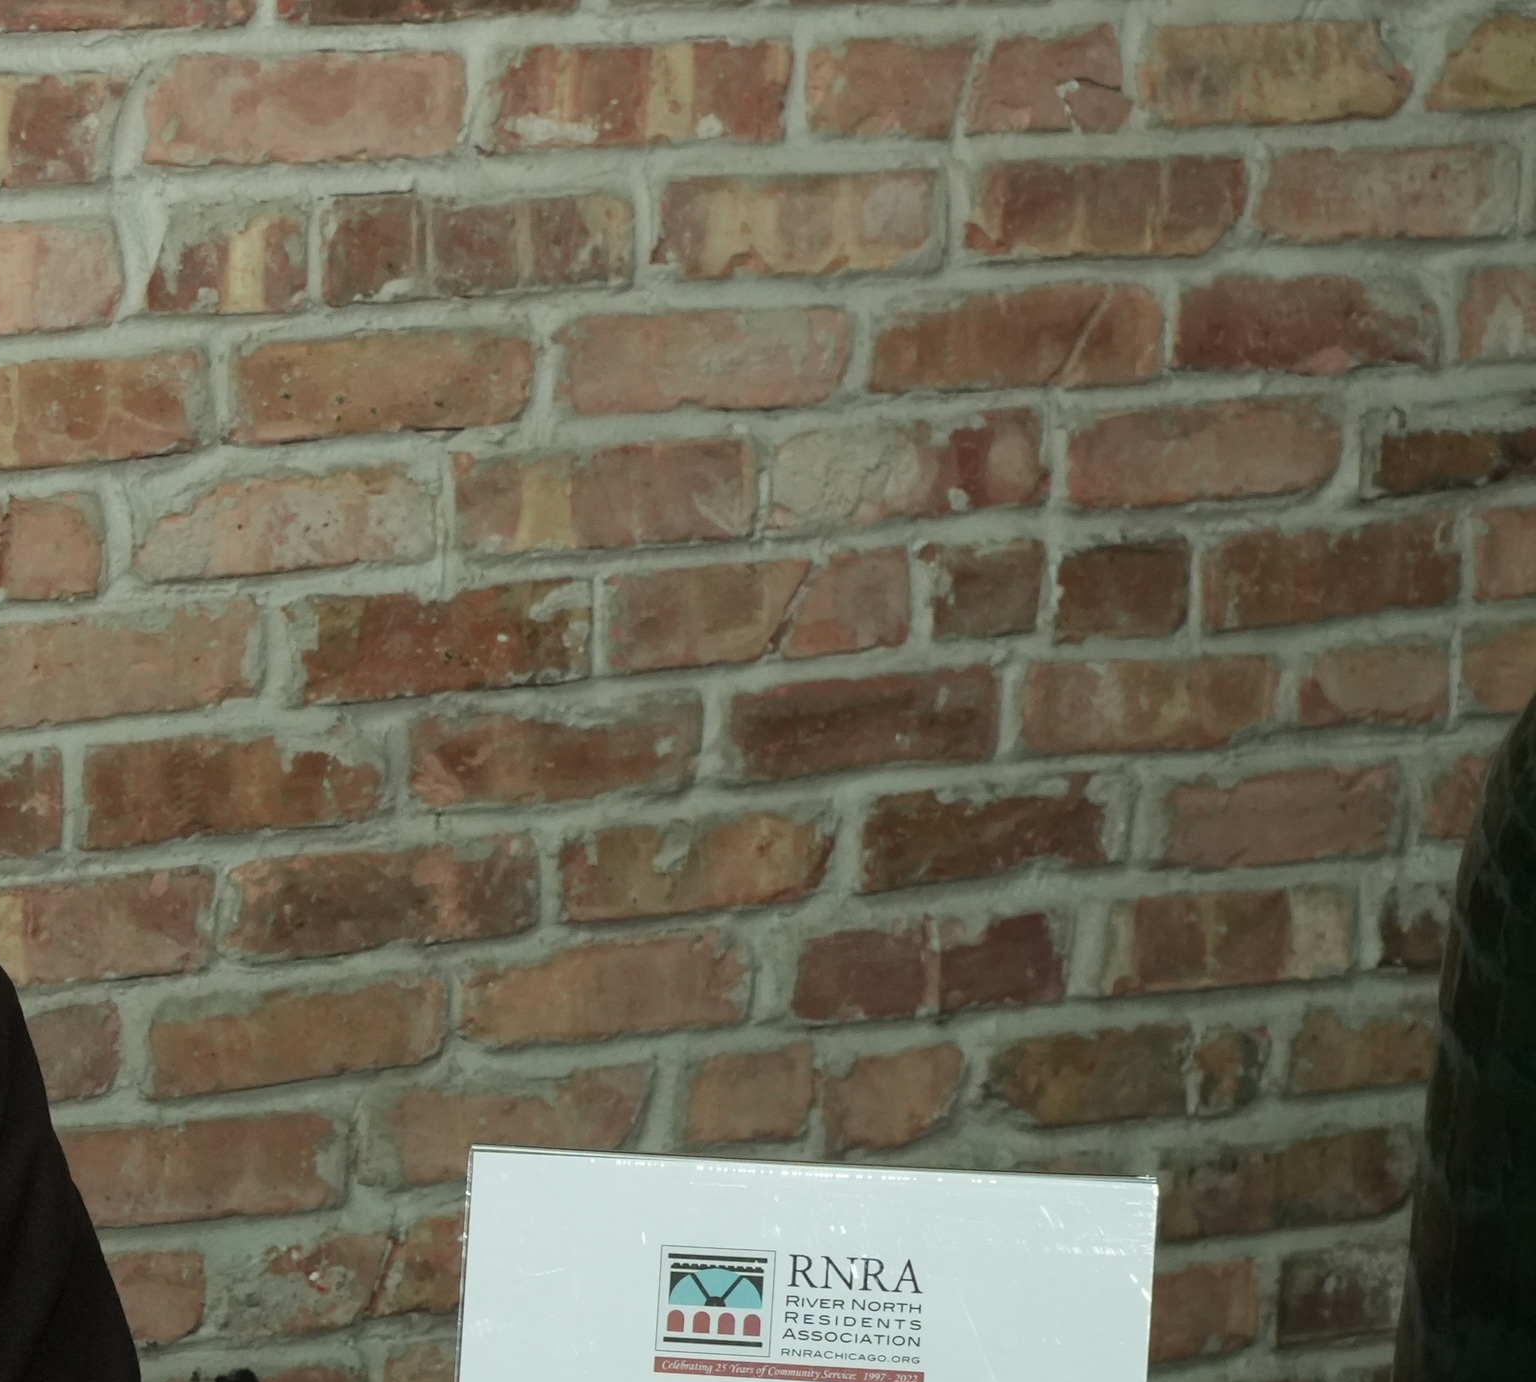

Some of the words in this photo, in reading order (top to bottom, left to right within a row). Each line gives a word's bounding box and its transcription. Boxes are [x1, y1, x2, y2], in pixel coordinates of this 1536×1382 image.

[787, 1254, 923, 1294] RNRA
[786, 1295, 845, 1310] RIVER
[852, 1299, 922, 1314] NORTH
[784, 1311, 922, 1330] RESIDENTS
[781, 1328, 920, 1347] ASSOCIATION
[661, 1359, 713, 1374] Celebrating
[715, 1363, 726, 1372] 25
[729, 1364, 754, 1374] Years
[756, 1365, 768, 1377] of
[768, 1366, 820, 1381] Community
[863, 1372, 886, 1382] 1997
